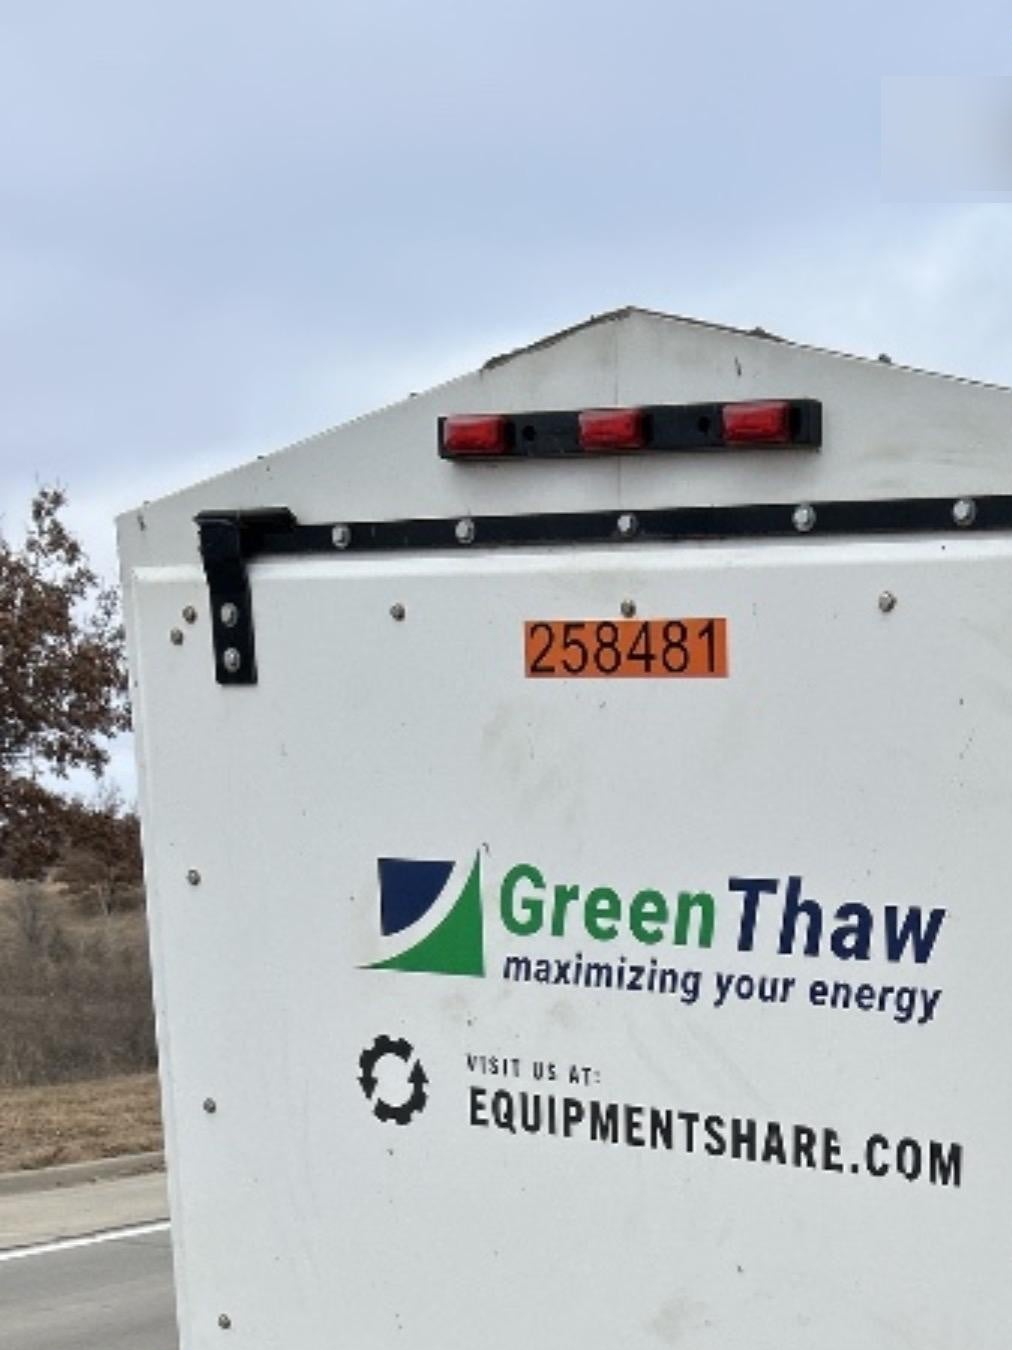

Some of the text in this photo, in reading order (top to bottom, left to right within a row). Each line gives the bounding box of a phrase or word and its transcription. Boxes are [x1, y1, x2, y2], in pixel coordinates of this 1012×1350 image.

[529, 621, 722, 675] 258481
[502, 951, 943, 1026] maximizing your energy
[466, 1052, 601, 1086] VISIT US AT:
[468, 1085, 964, 1189] EQUIPMENTSHARE.COM
